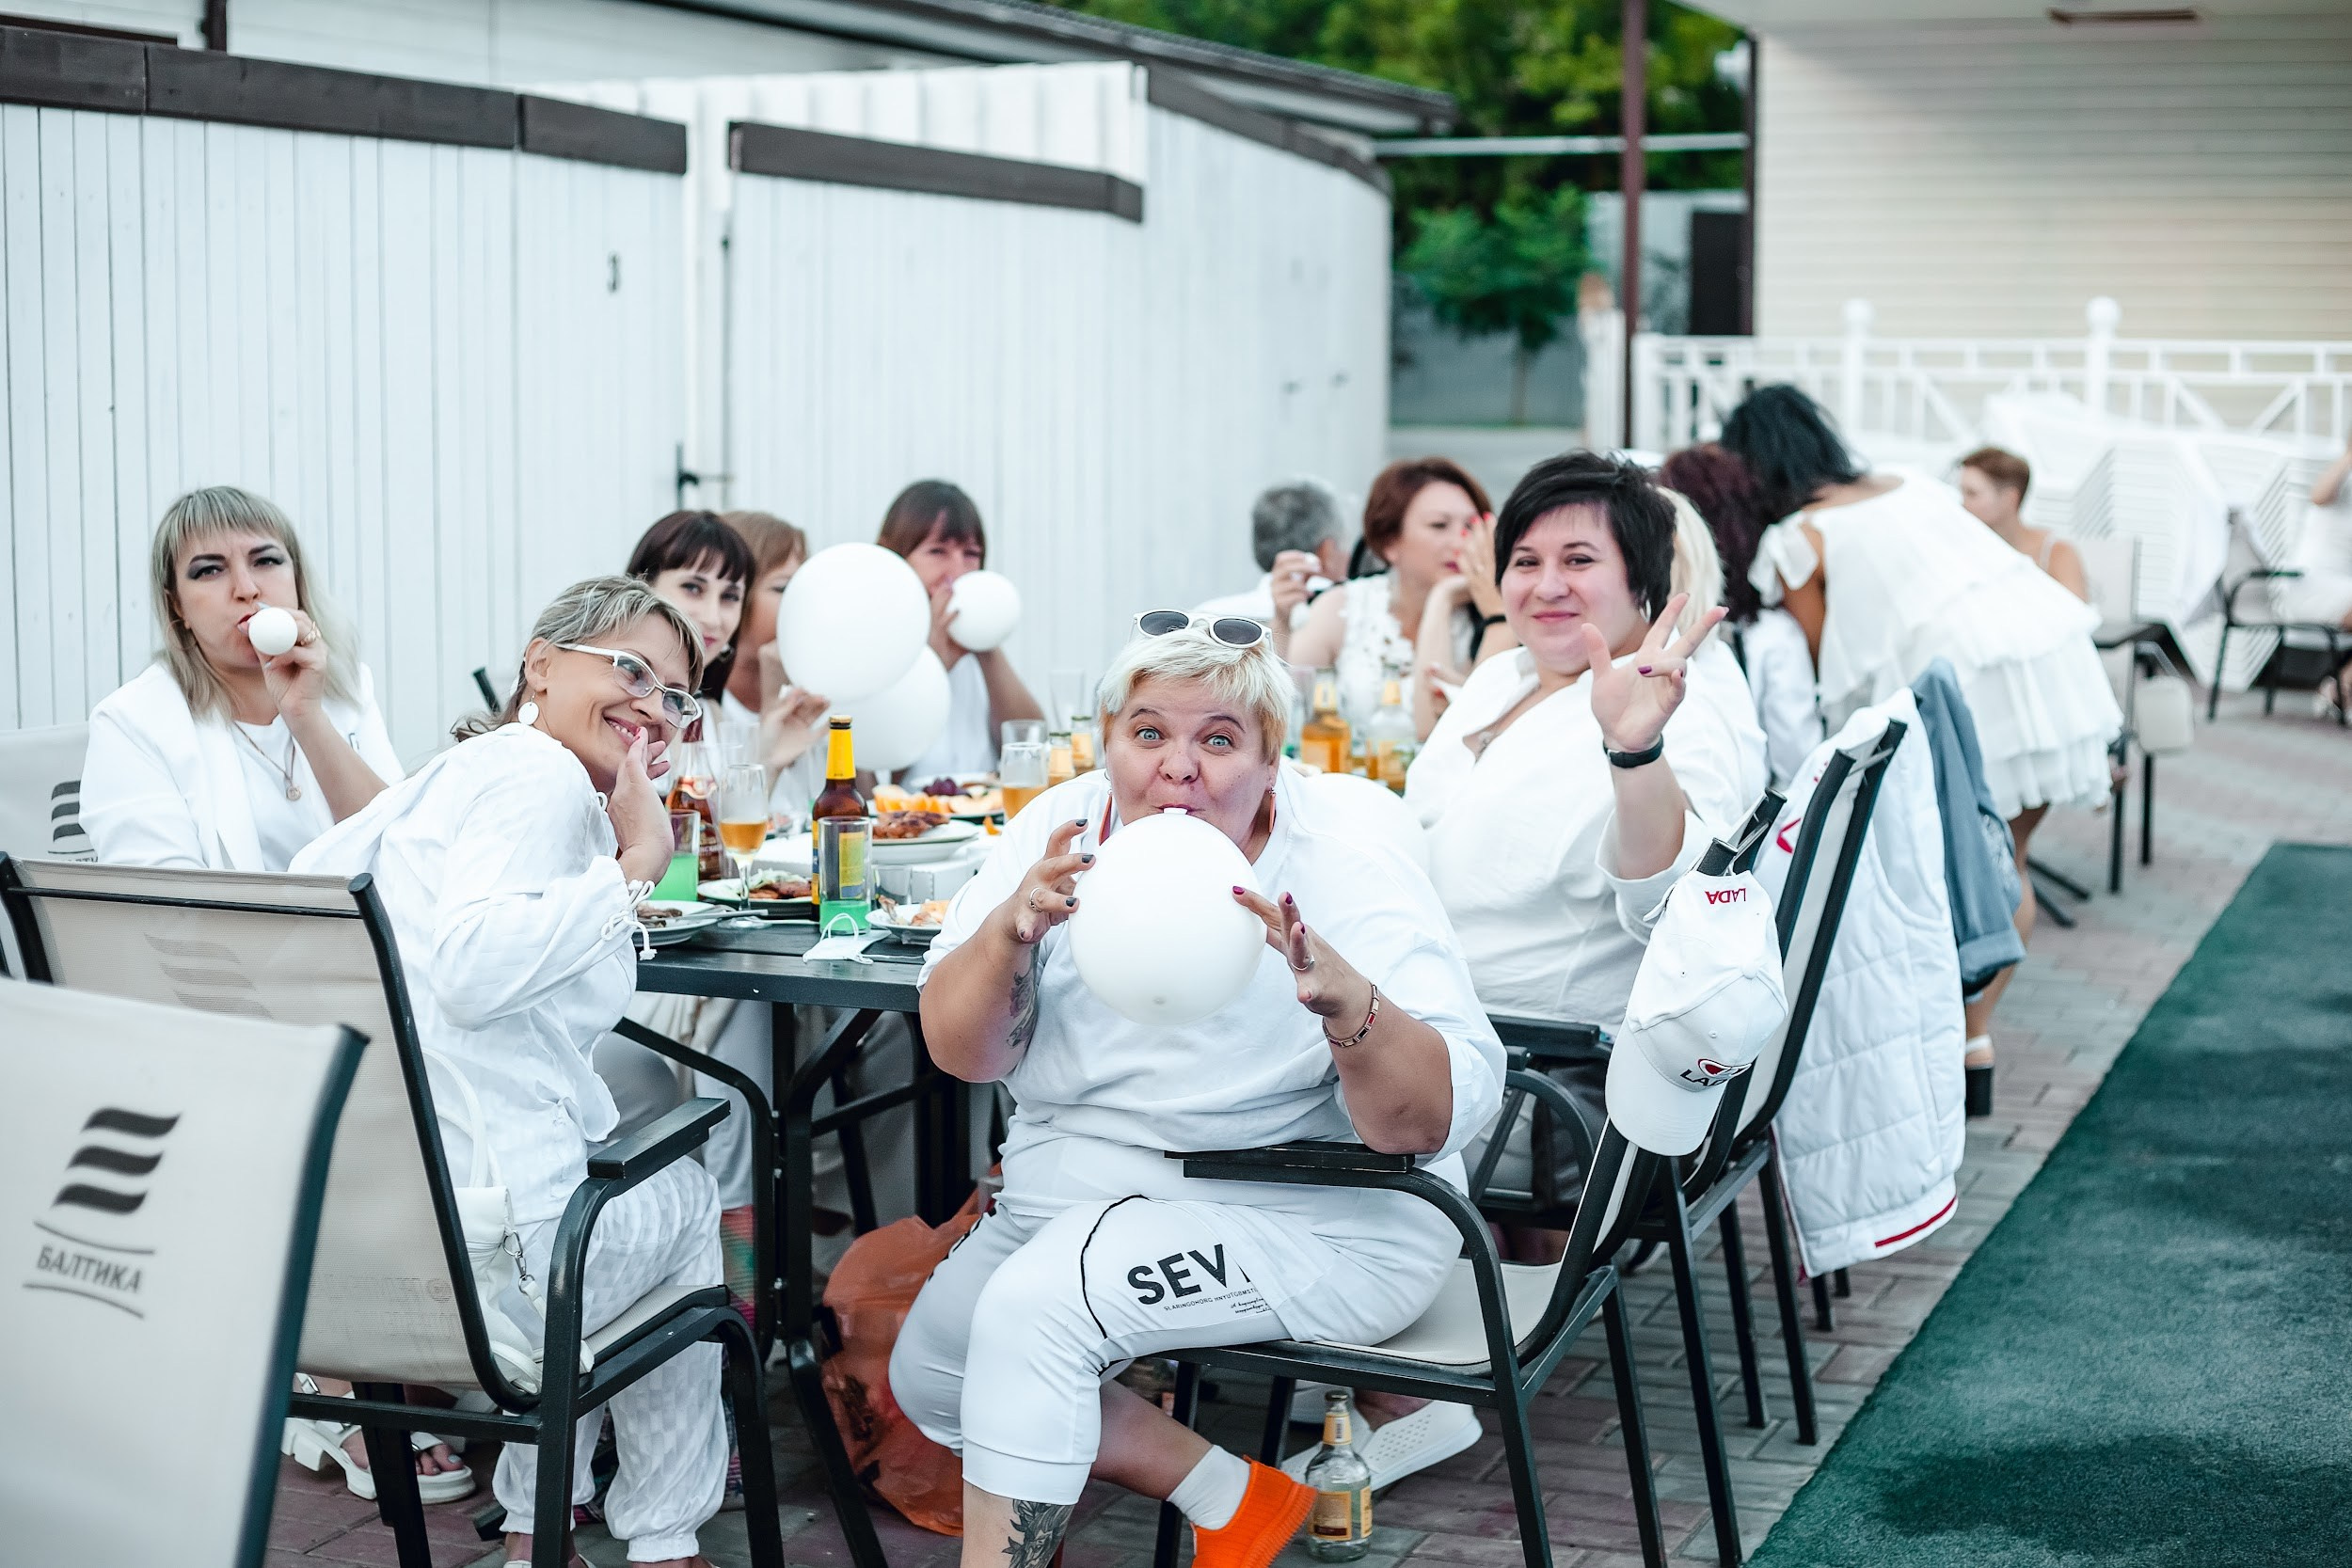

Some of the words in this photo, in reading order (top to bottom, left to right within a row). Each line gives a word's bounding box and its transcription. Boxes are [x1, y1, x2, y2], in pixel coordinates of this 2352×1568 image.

[1705, 888, 1746, 904] LADA
[1680, 1069, 1729, 1087] LAD
[36, 1243, 143, 1293] БАЛТИКА
[1127, 1243, 1250, 1305] SEV
